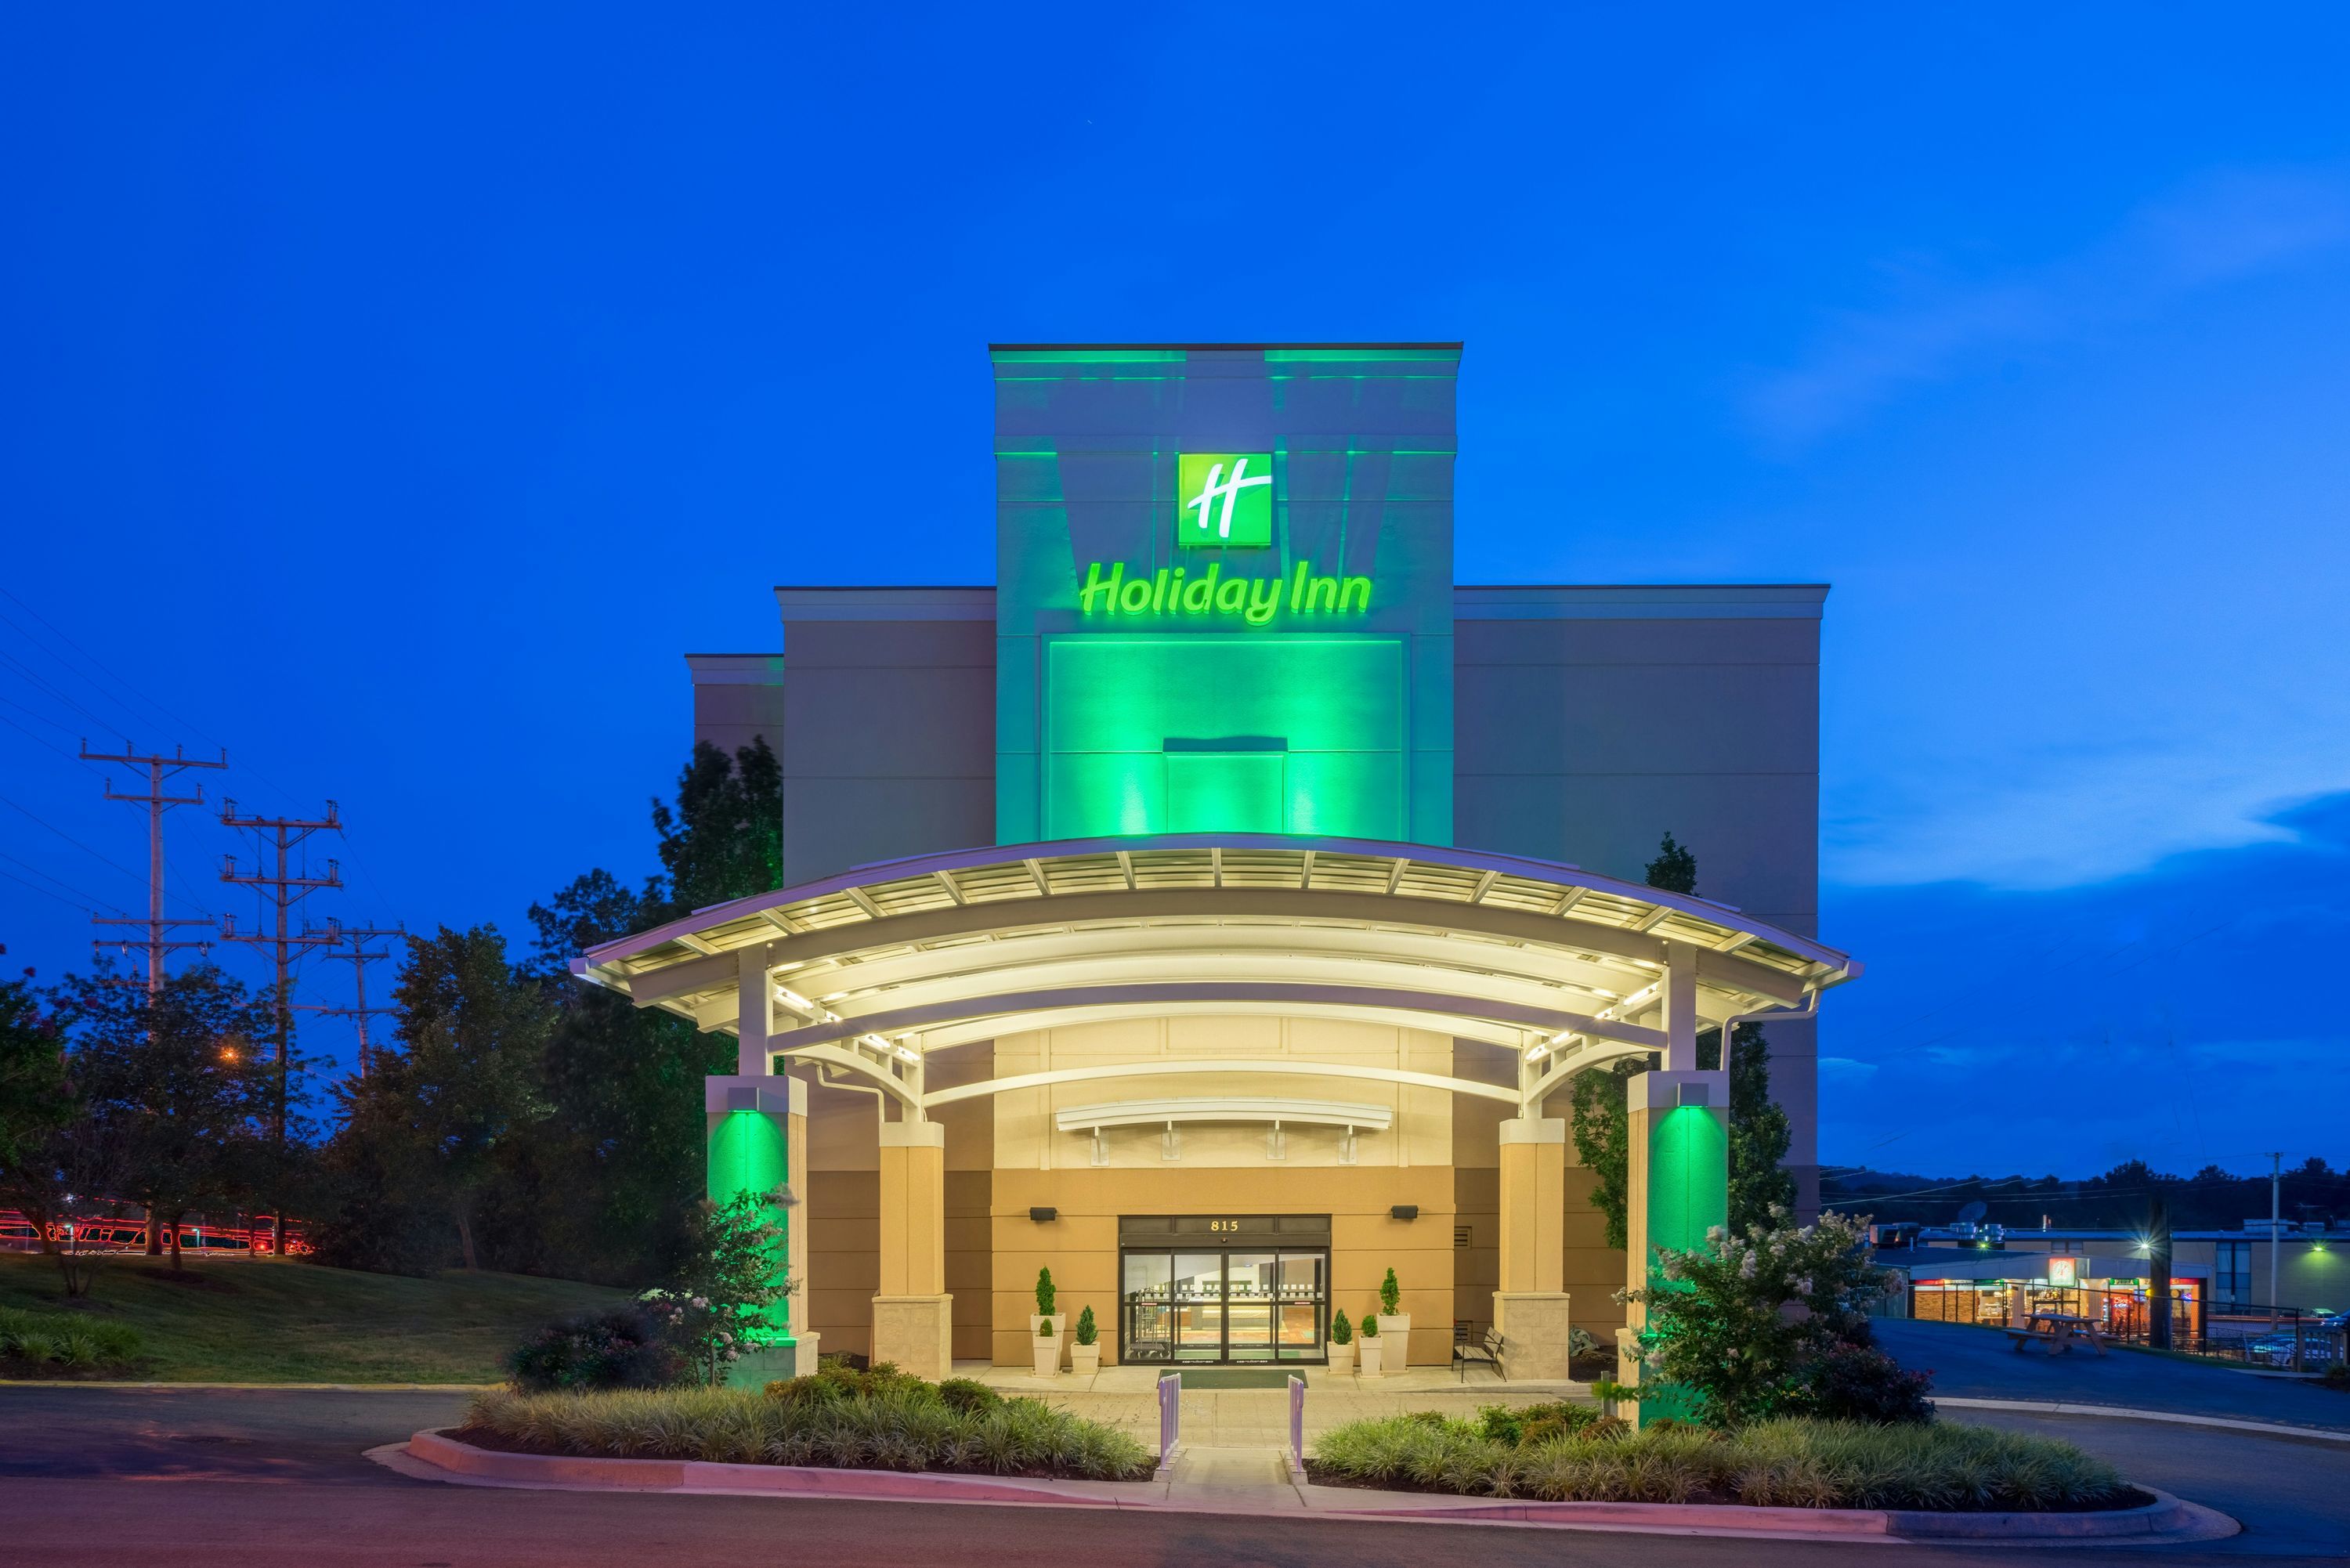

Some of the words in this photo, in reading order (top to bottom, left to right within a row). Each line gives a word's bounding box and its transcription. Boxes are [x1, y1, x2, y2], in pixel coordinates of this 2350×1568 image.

[1187, 458, 1273, 538] H
[1079, 562, 1282, 626] Holiday
[1290, 561, 1371, 613] Inn
[1210, 1220, 1238, 1231] 815
